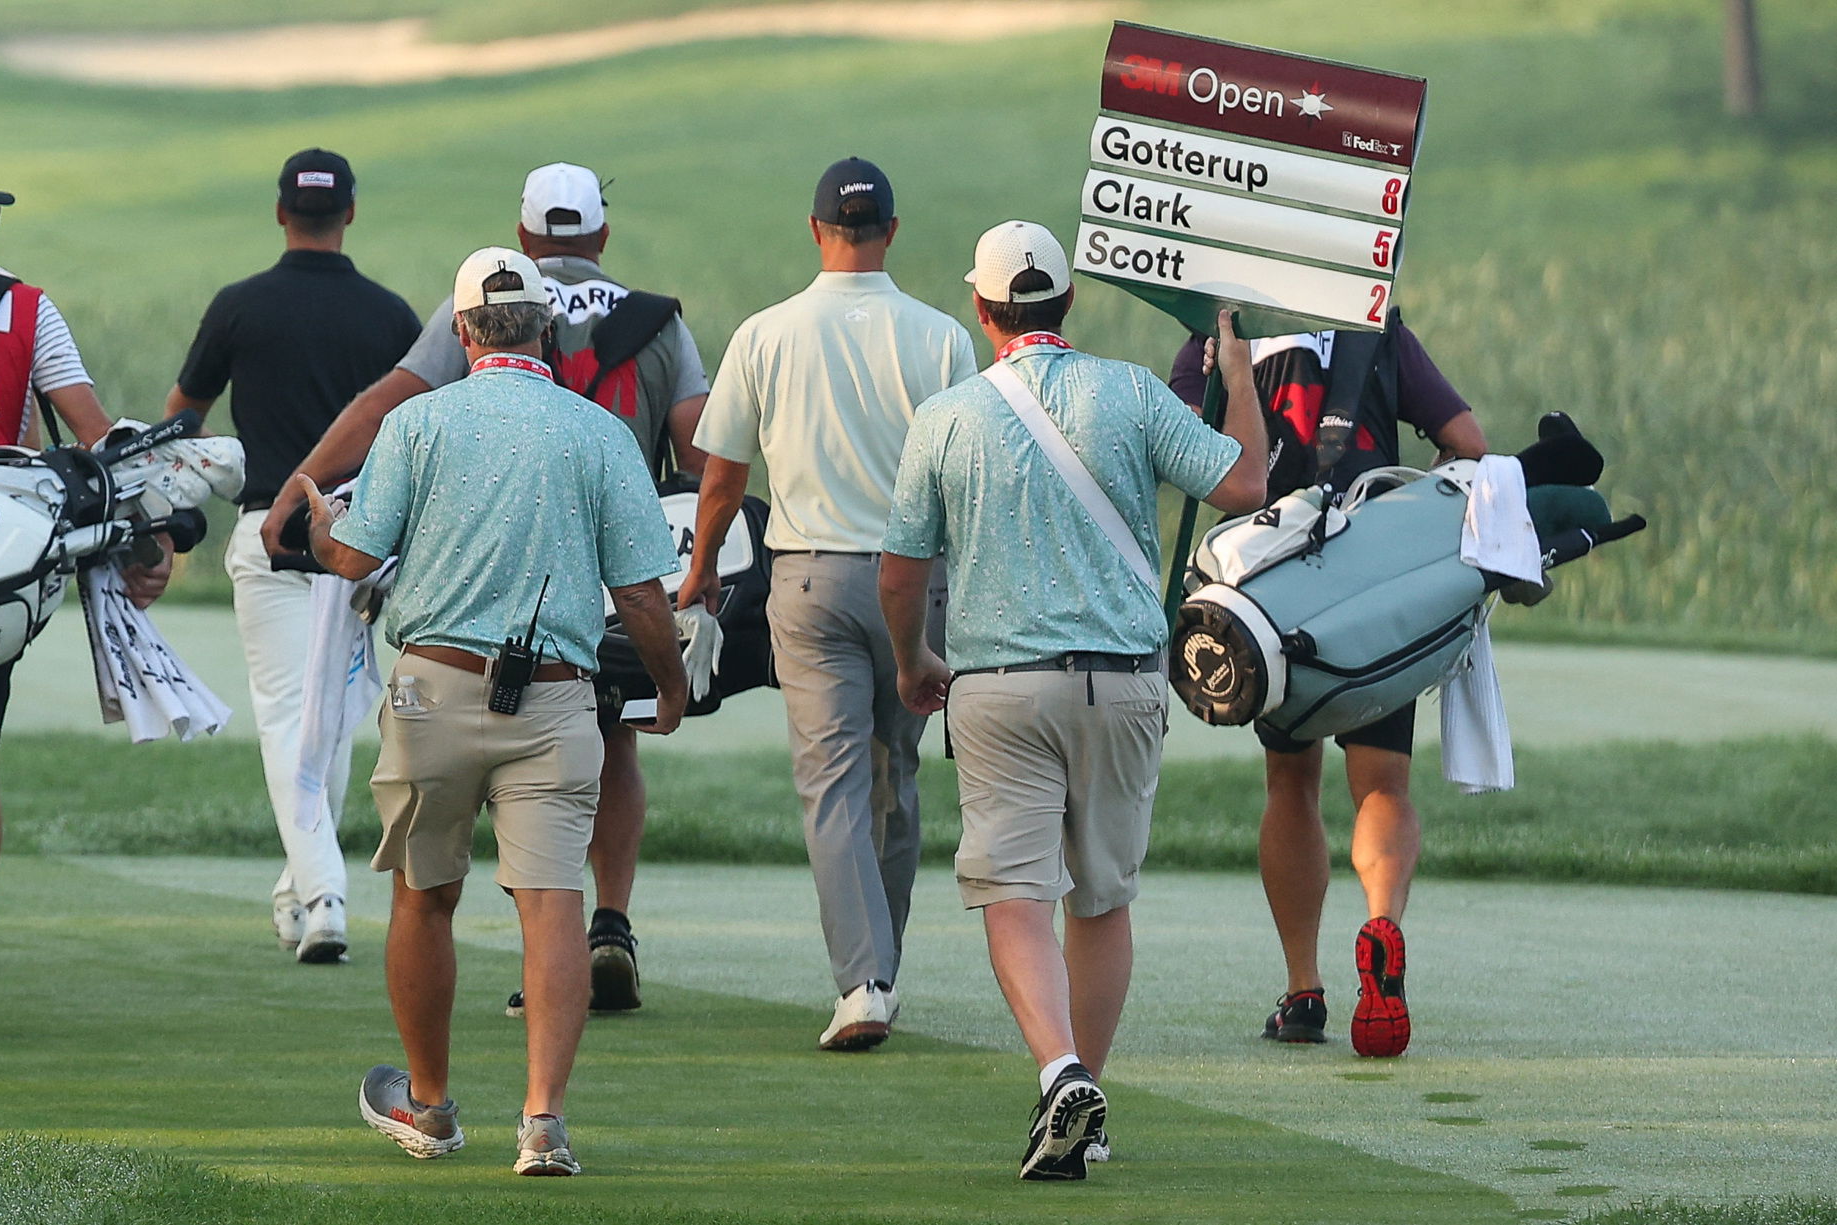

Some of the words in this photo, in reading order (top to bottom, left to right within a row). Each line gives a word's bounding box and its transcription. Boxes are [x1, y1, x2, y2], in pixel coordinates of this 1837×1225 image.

[1119, 54, 1182, 97] 3M
[1187, 67, 1285, 118] Open
[1100, 125, 1269, 192] Gotterup
[1381, 178, 1402, 216] 8
[1353, 135, 1388, 155] FedEx
[840, 182, 874, 196] LifeWear
[1092, 179, 1194, 229] Clark
[1372, 230, 1393, 269] 5
[1085, 230, 1185, 281] Scott
[1366, 284, 1387, 324] 2
[1184, 632, 1226, 682] JONES
